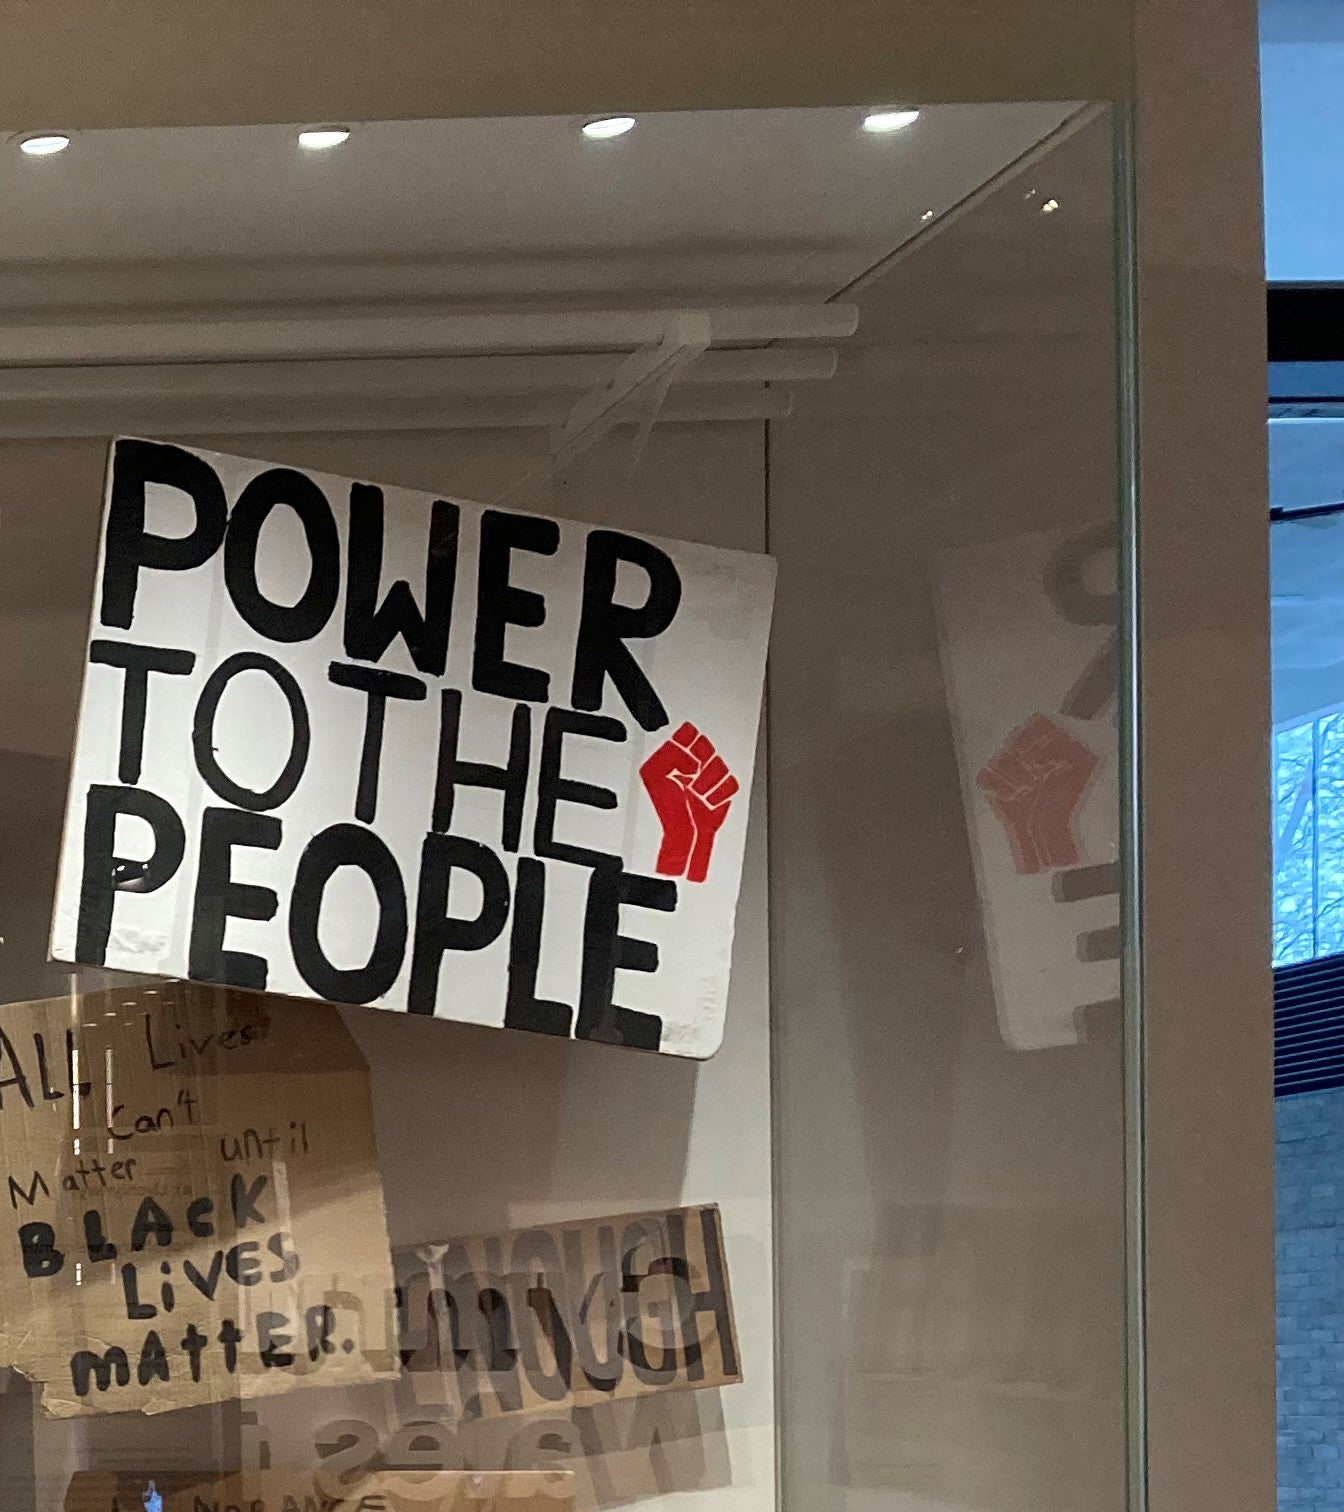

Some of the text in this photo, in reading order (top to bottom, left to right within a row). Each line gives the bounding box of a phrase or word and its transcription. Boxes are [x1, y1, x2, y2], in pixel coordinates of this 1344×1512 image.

[99, 439, 682, 731] POWER
[90, 640, 628, 870] TO THE
[76, 784, 678, 1053] PEOPLE
[145, 1014, 259, 1070] Lives
[9, 1121, 309, 1209] Matter until
[18, 1173, 268, 1279] BLACK
